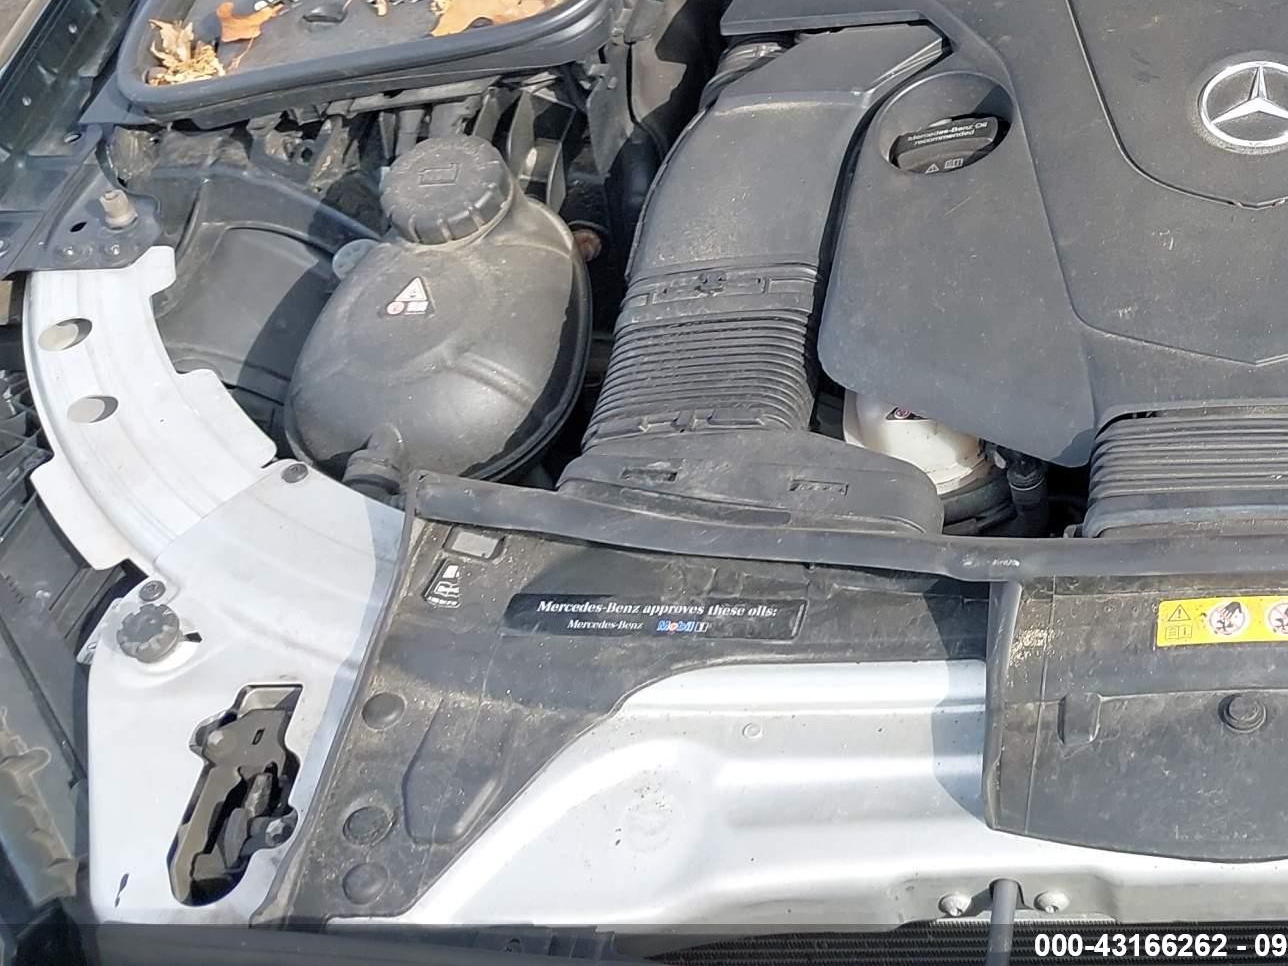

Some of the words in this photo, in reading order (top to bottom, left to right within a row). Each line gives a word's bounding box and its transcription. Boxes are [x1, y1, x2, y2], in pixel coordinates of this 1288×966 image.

[907, 124, 974, 142] Mercedes-Benz
[914, 129, 975, 146] recommended
[536, 599, 640, 614] Mercedes-Benz
[642, 603, 705, 616] approves
[707, 603, 745, 617] these
[566, 619, 643, 630] Mercedes-Benz
[656, 620, 695, 633] Mobil
